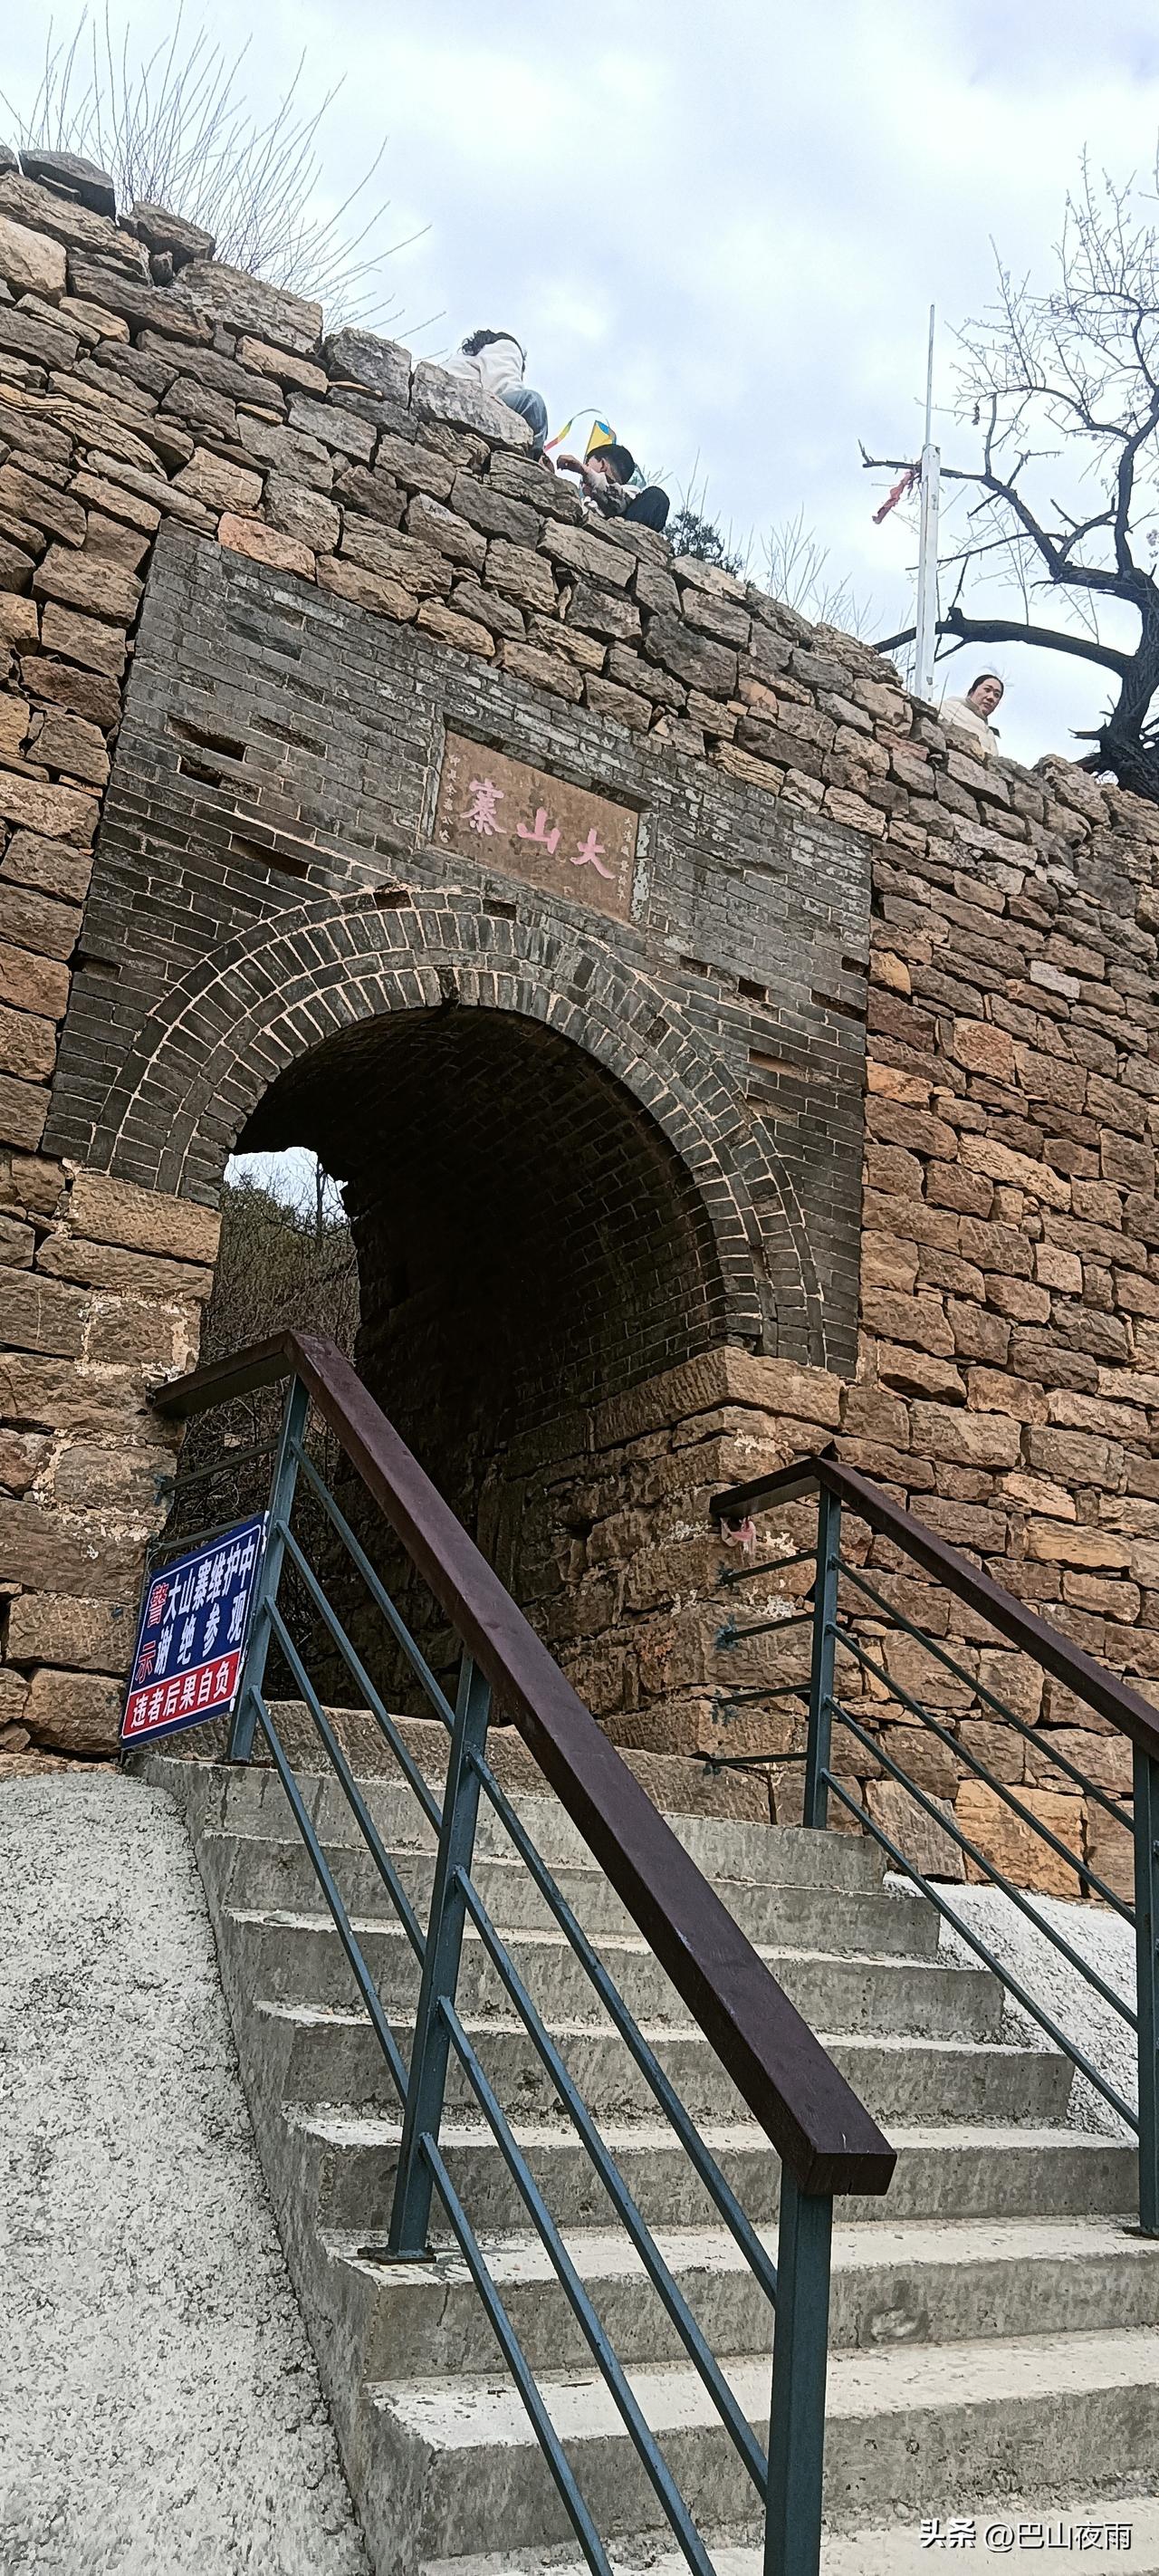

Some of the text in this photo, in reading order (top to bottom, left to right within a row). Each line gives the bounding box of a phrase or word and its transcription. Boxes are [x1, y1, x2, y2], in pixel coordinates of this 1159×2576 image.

[460, 778, 617, 879] 大山寨
[163, 1535, 255, 1623] 大山寨维护中
[135, 1582, 169, 1684] 警示
[154, 1590, 247, 1676] 谢绝参观
[130, 1660, 229, 1729] 违者后果自负
